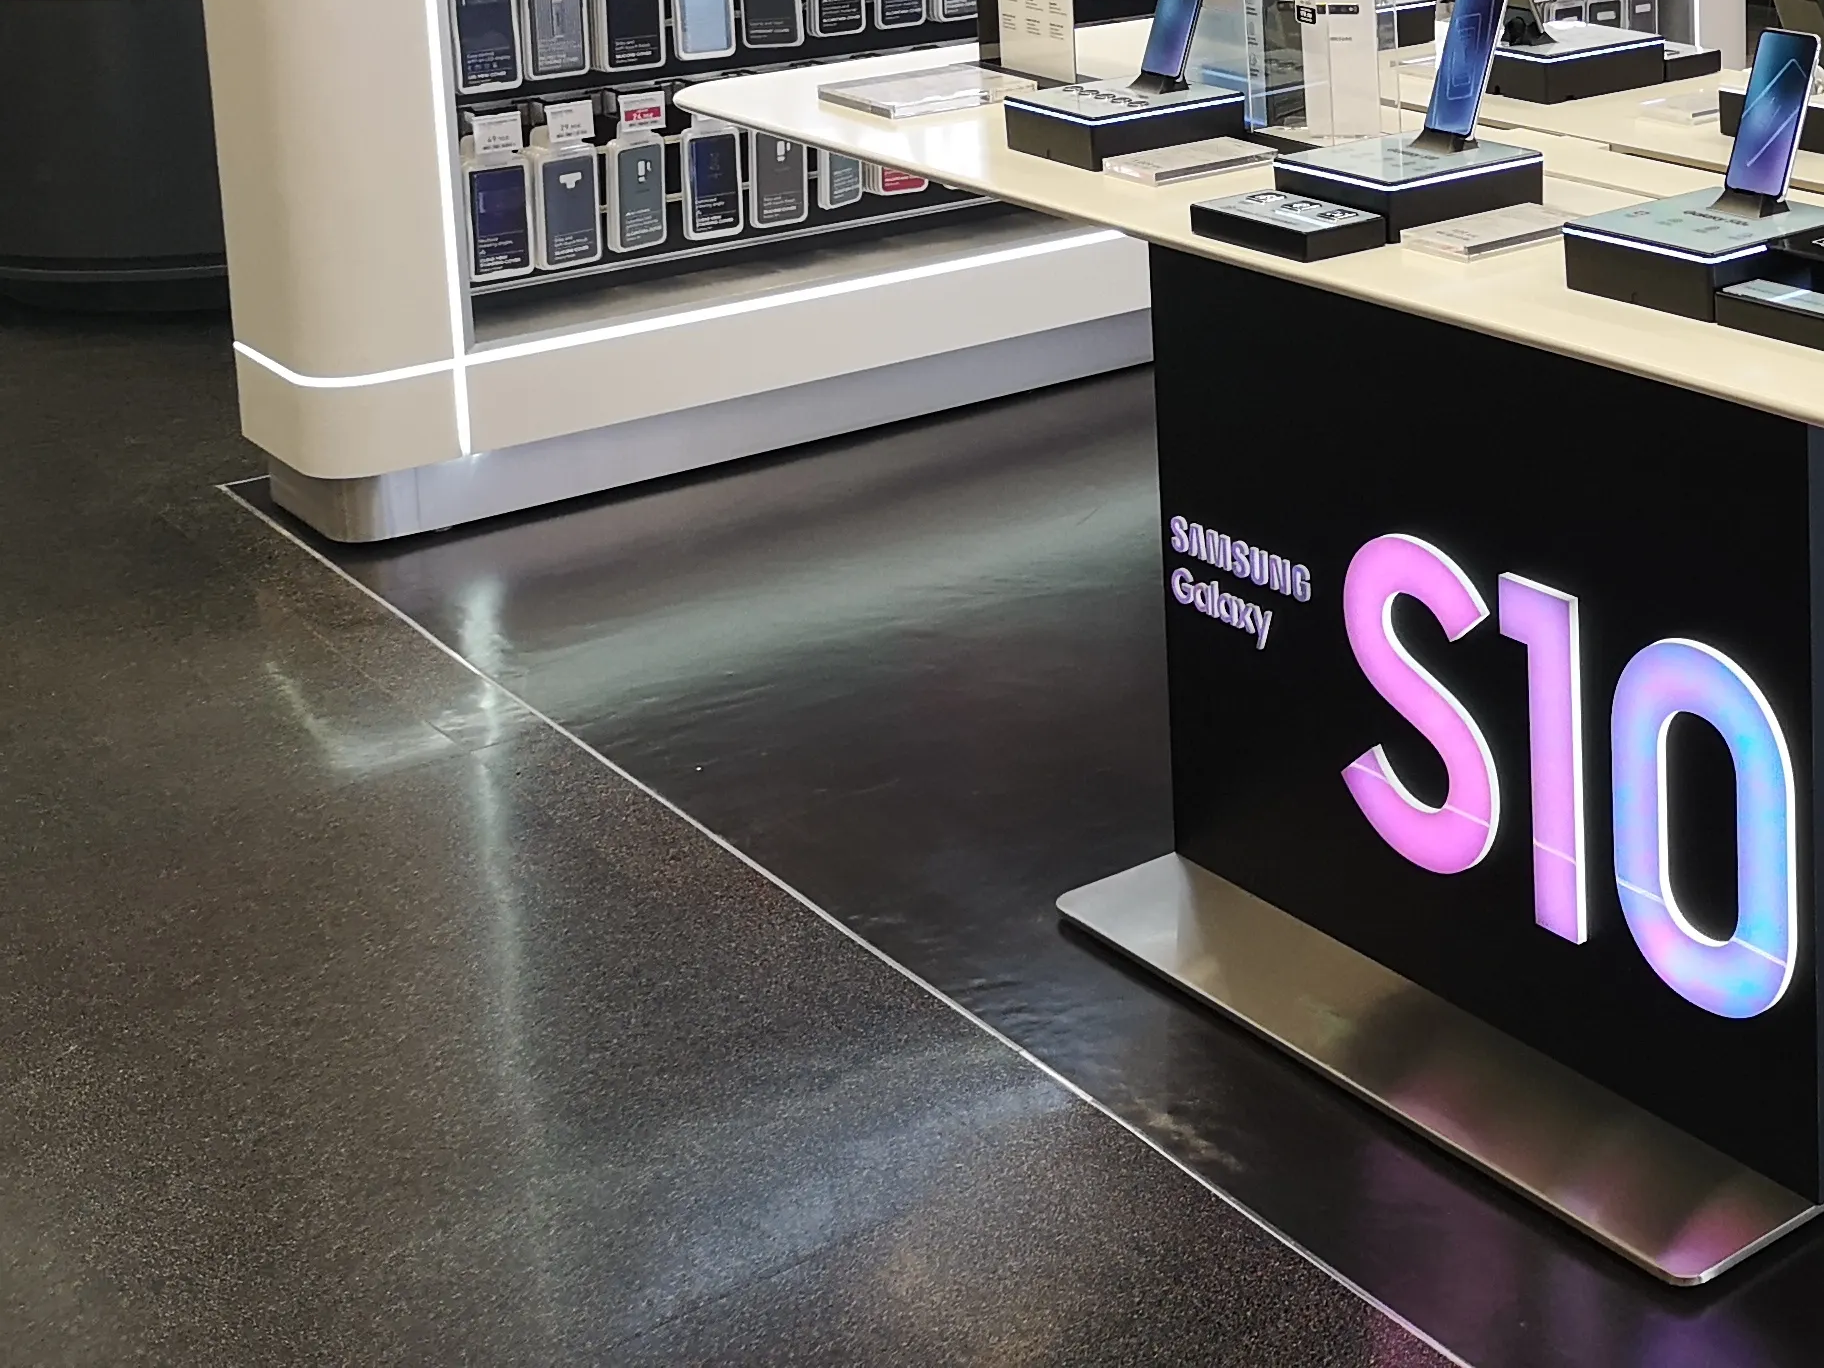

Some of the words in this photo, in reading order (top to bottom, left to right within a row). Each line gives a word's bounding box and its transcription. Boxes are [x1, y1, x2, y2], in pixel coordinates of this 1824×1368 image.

[1170, 515, 1312, 603] SAMSUNG
[1170, 567, 1273, 650] Galaxy
[1341, 533, 1798, 1019] S10
